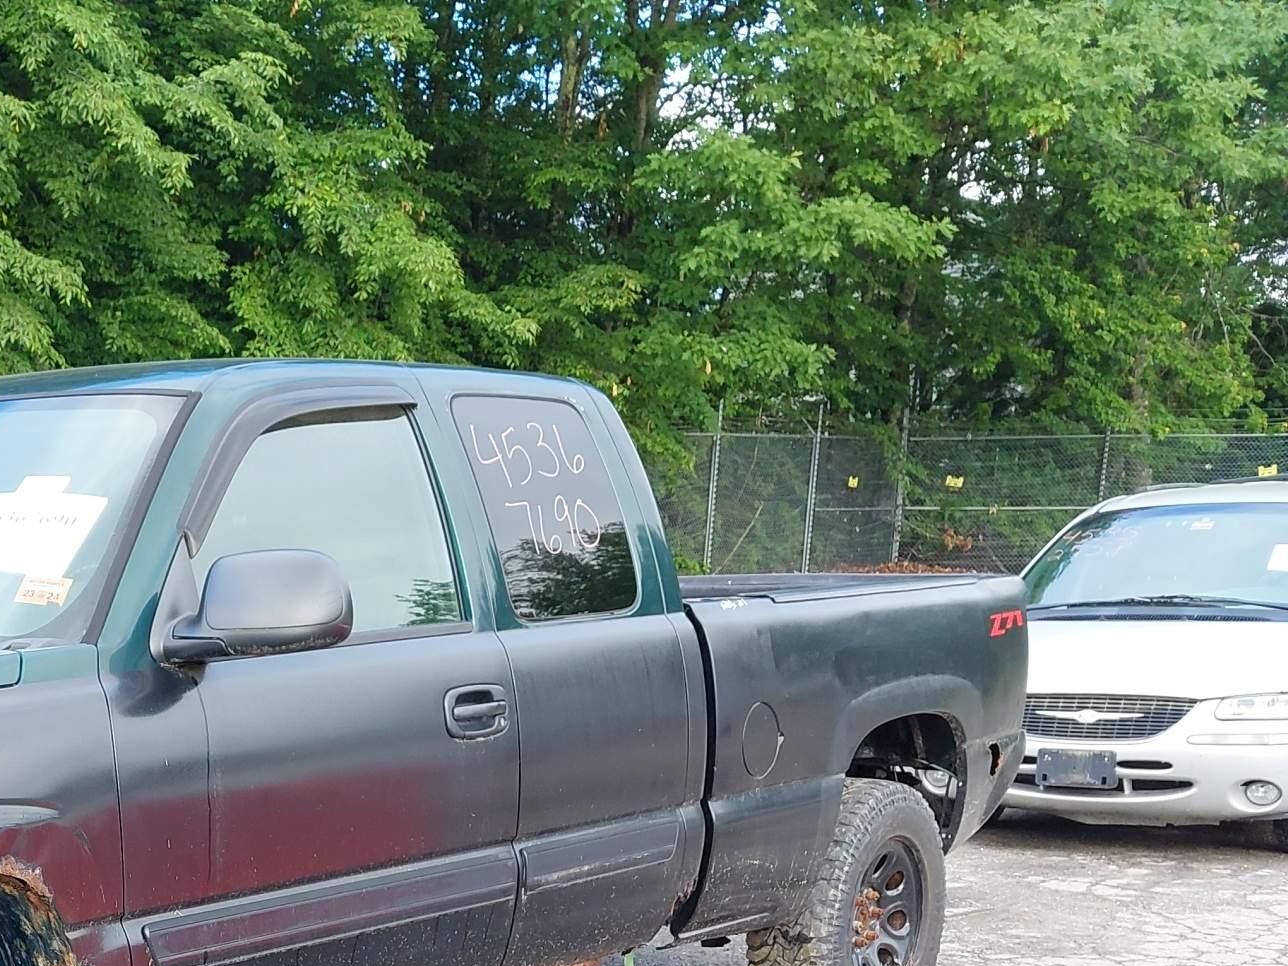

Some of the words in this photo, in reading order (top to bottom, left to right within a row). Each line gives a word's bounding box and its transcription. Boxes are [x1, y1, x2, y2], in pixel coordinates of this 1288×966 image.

[469, 422, 586, 489] 4536
[504, 494, 602, 556] 7690
[989, 608, 1024, 638] Z71
